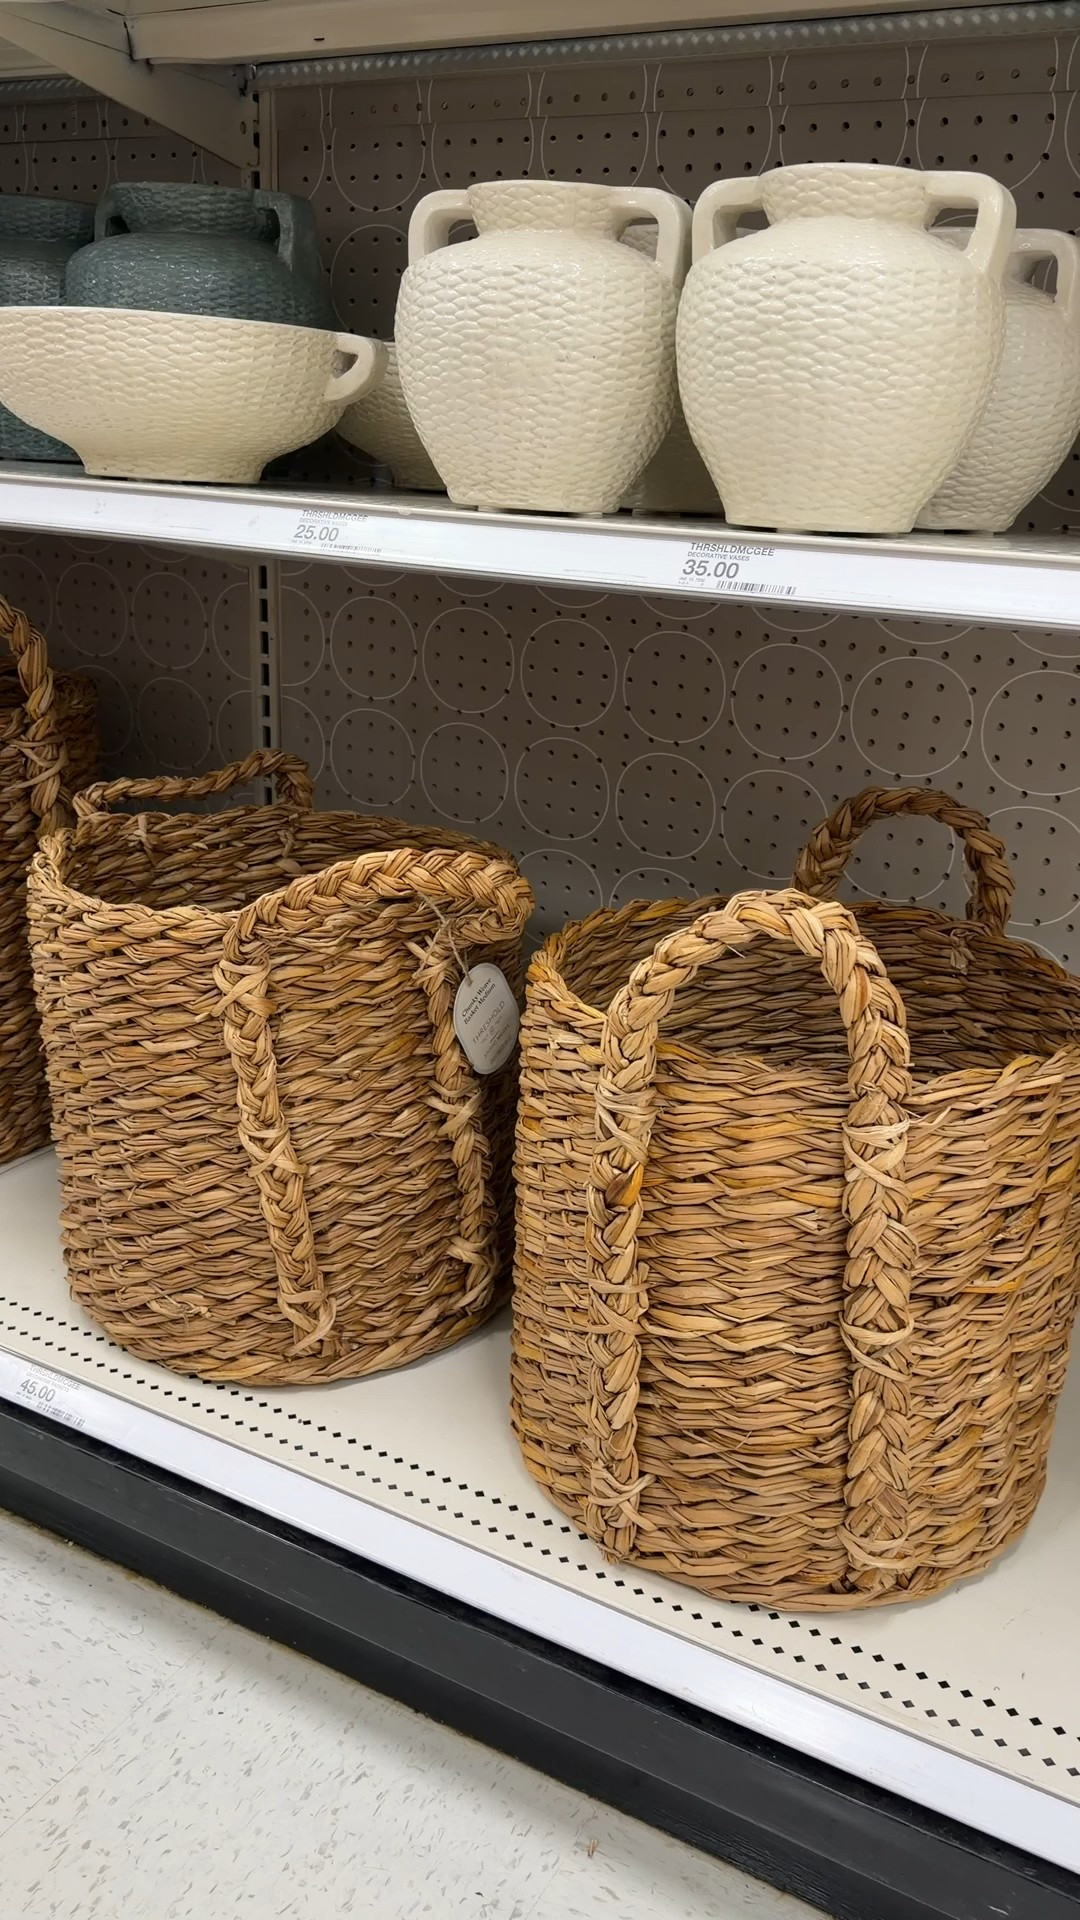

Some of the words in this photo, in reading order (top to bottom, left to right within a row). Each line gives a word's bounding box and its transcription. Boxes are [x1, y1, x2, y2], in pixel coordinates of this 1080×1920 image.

[302, 510, 368, 522] THRSHLDMCGEE
[294, 525, 339, 541] 25.00
[687, 551, 728, 560] DECORATIVE
[691, 542, 775, 556] THRSHLDMCGEE
[683, 559, 739, 578] 35.00
[462, 996, 478, 1017] Chunky
[477, 978, 491, 995] Weave
[464, 1007, 479, 1024] Basket
[479, 983, 495, 1005] Medium
[473, 1001, 505, 1044] THRESHOLD
[20, 1379, 55, 1401] 45.00
